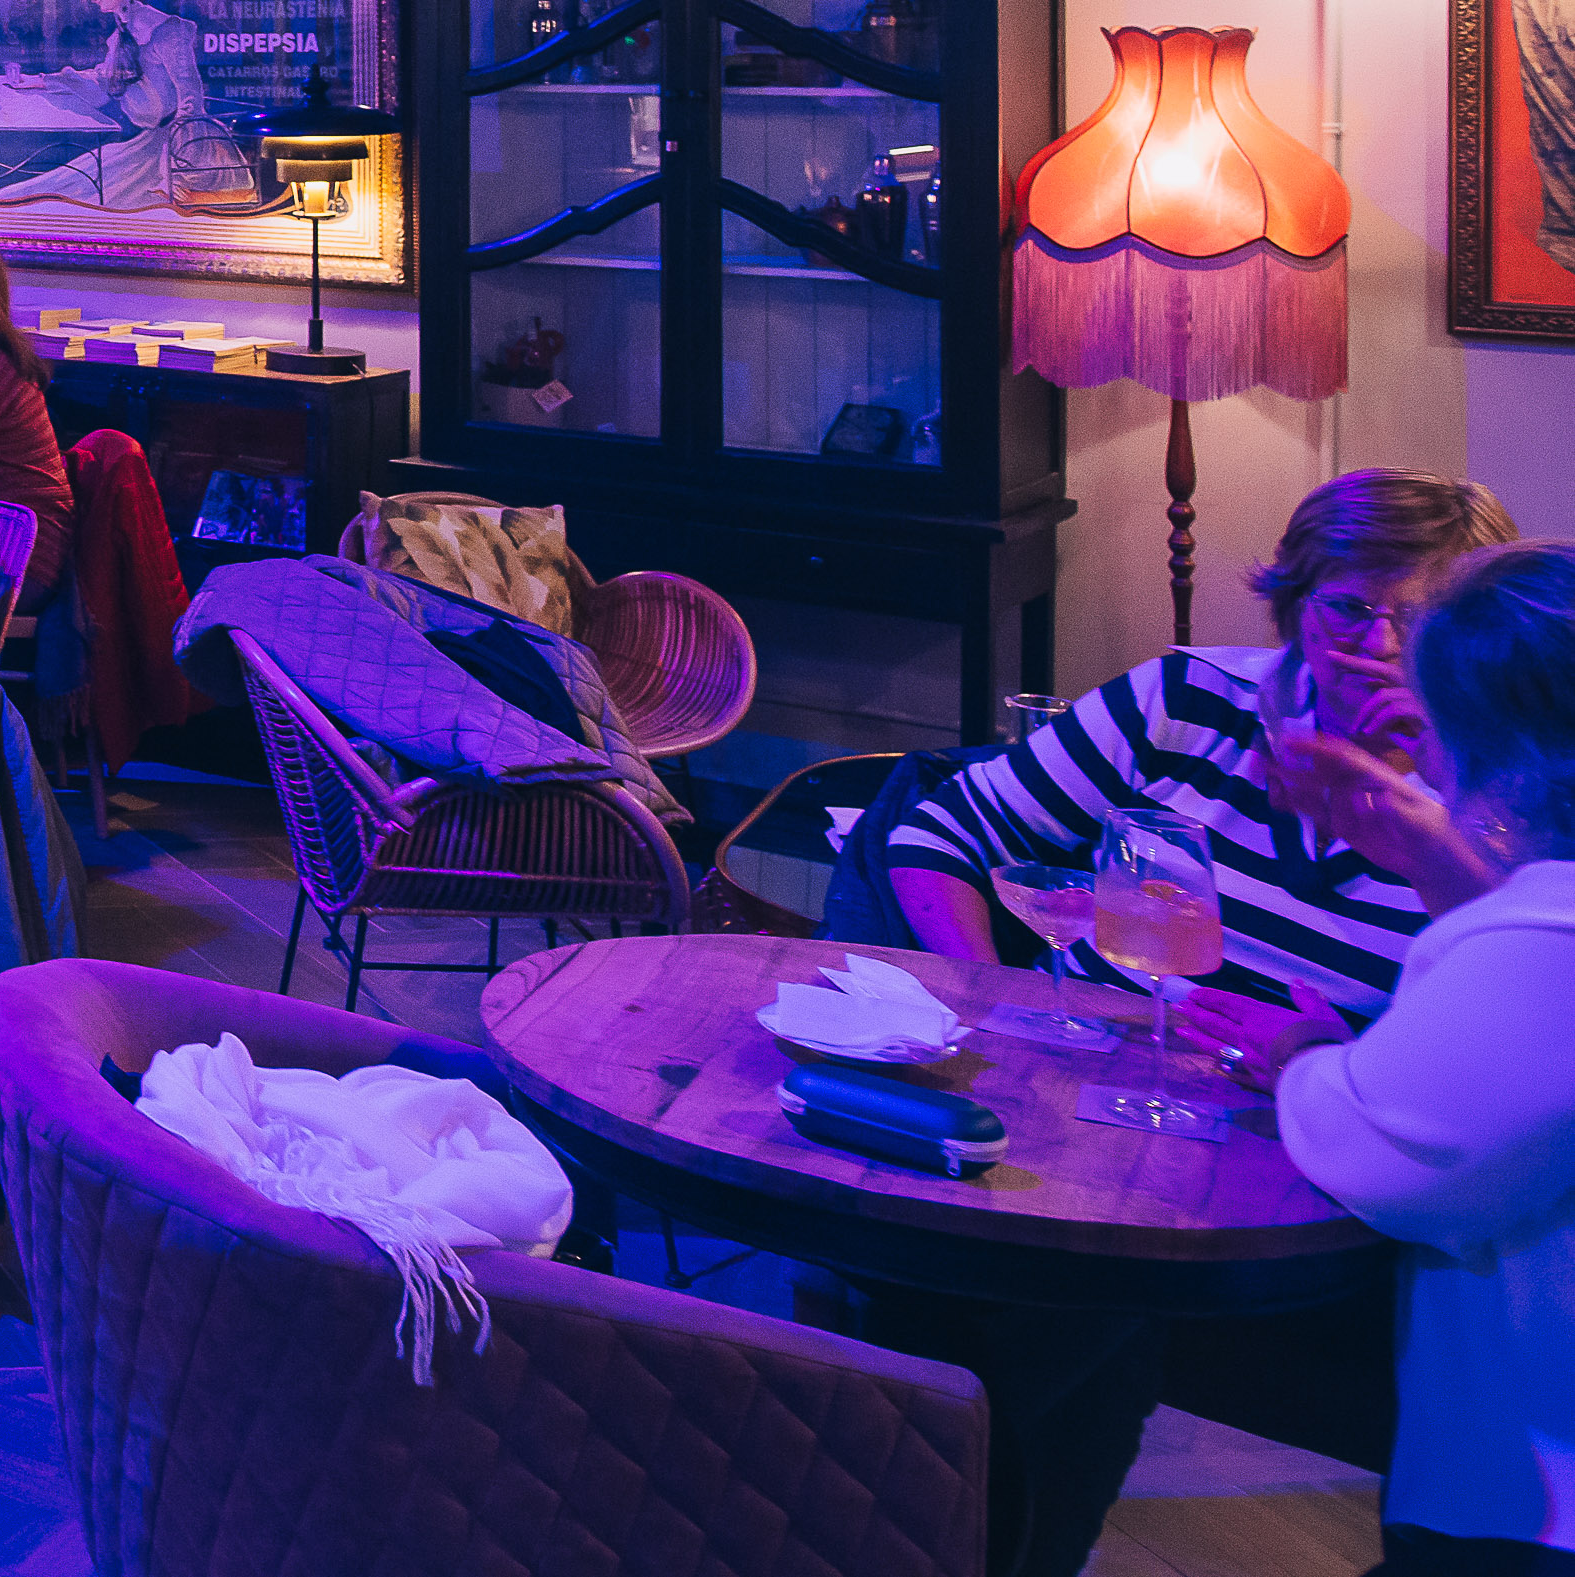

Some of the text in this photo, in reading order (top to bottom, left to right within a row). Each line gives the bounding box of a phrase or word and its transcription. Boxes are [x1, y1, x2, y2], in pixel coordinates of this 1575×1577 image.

[208, 0, 346, 20] LA NEURASTENIA
[203, 32, 320, 54] DISPEPSIA
[207, 64, 339, 79] CATARROS GASRO
[224, 84, 305, 99] INTESTINAL
